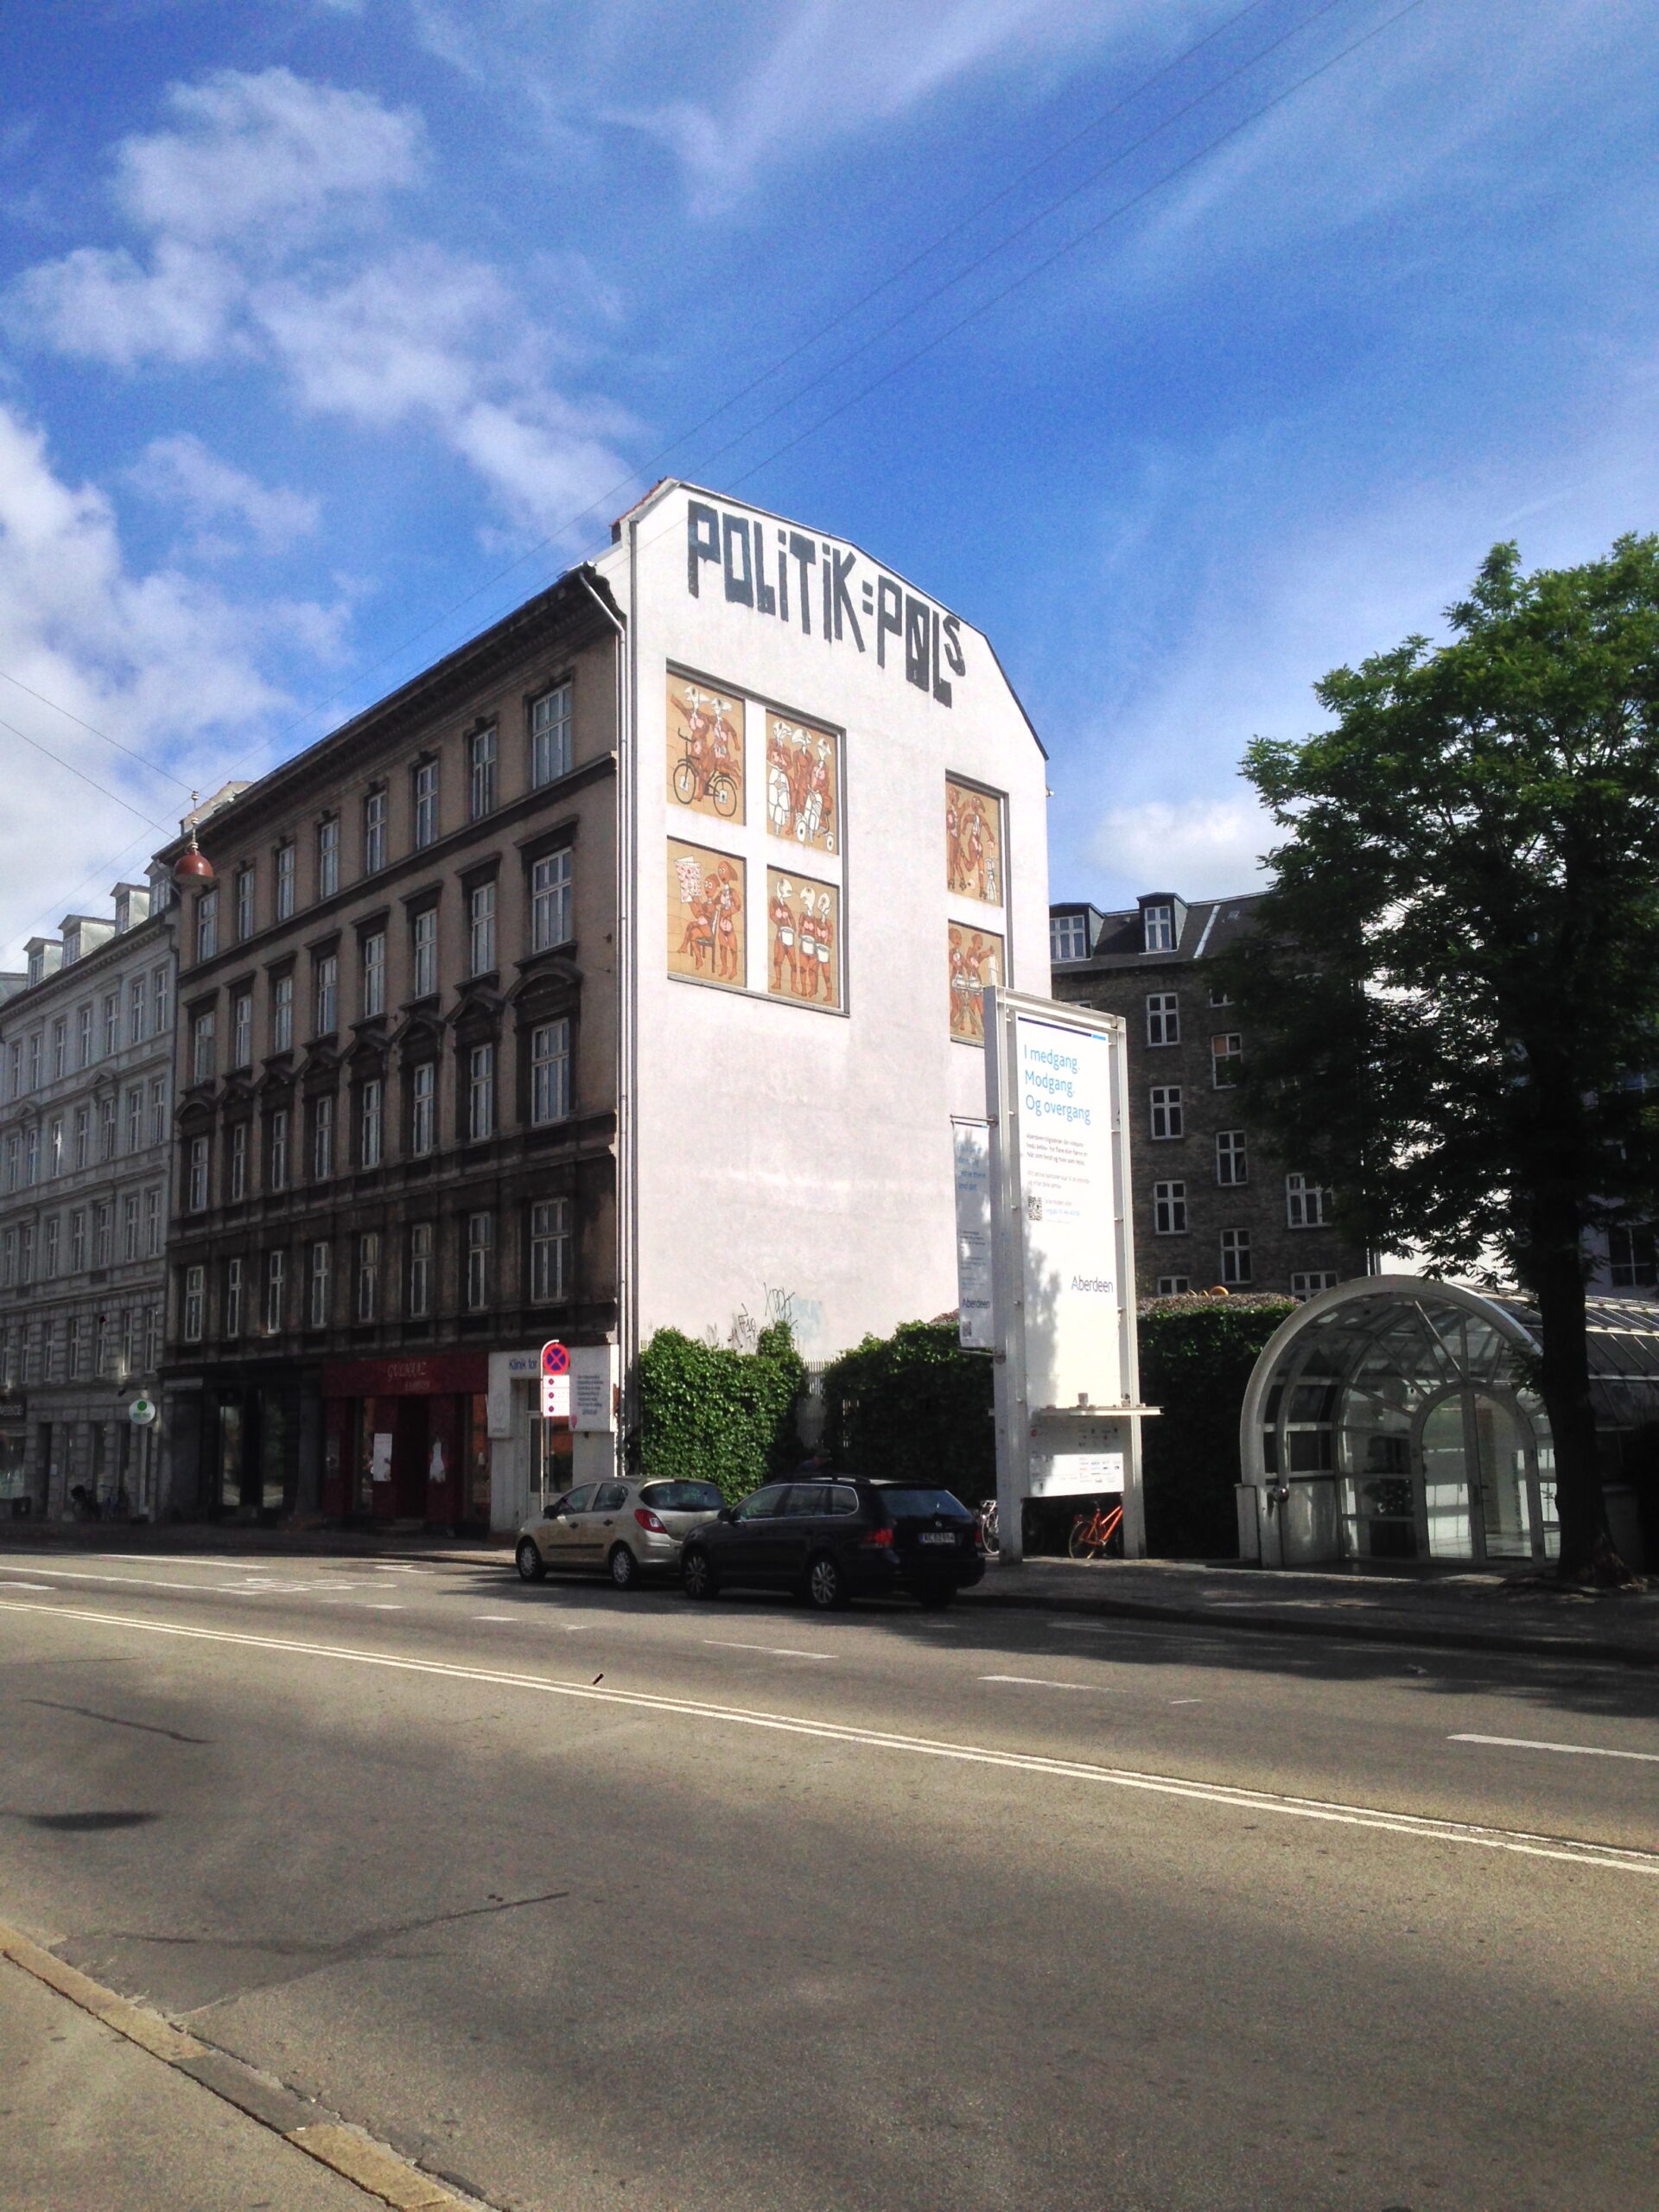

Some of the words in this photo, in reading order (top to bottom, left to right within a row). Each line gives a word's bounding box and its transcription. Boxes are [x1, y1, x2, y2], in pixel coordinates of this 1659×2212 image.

[1030, 1048, 1080, 1074] medgang.
[1026, 1094, 1042, 1116] Og
[1044, 1101, 1090, 1126] overgang
[1071, 1274, 1114, 1294] Aberdeen
[962, 1298, 990, 1309] Aberdeen
